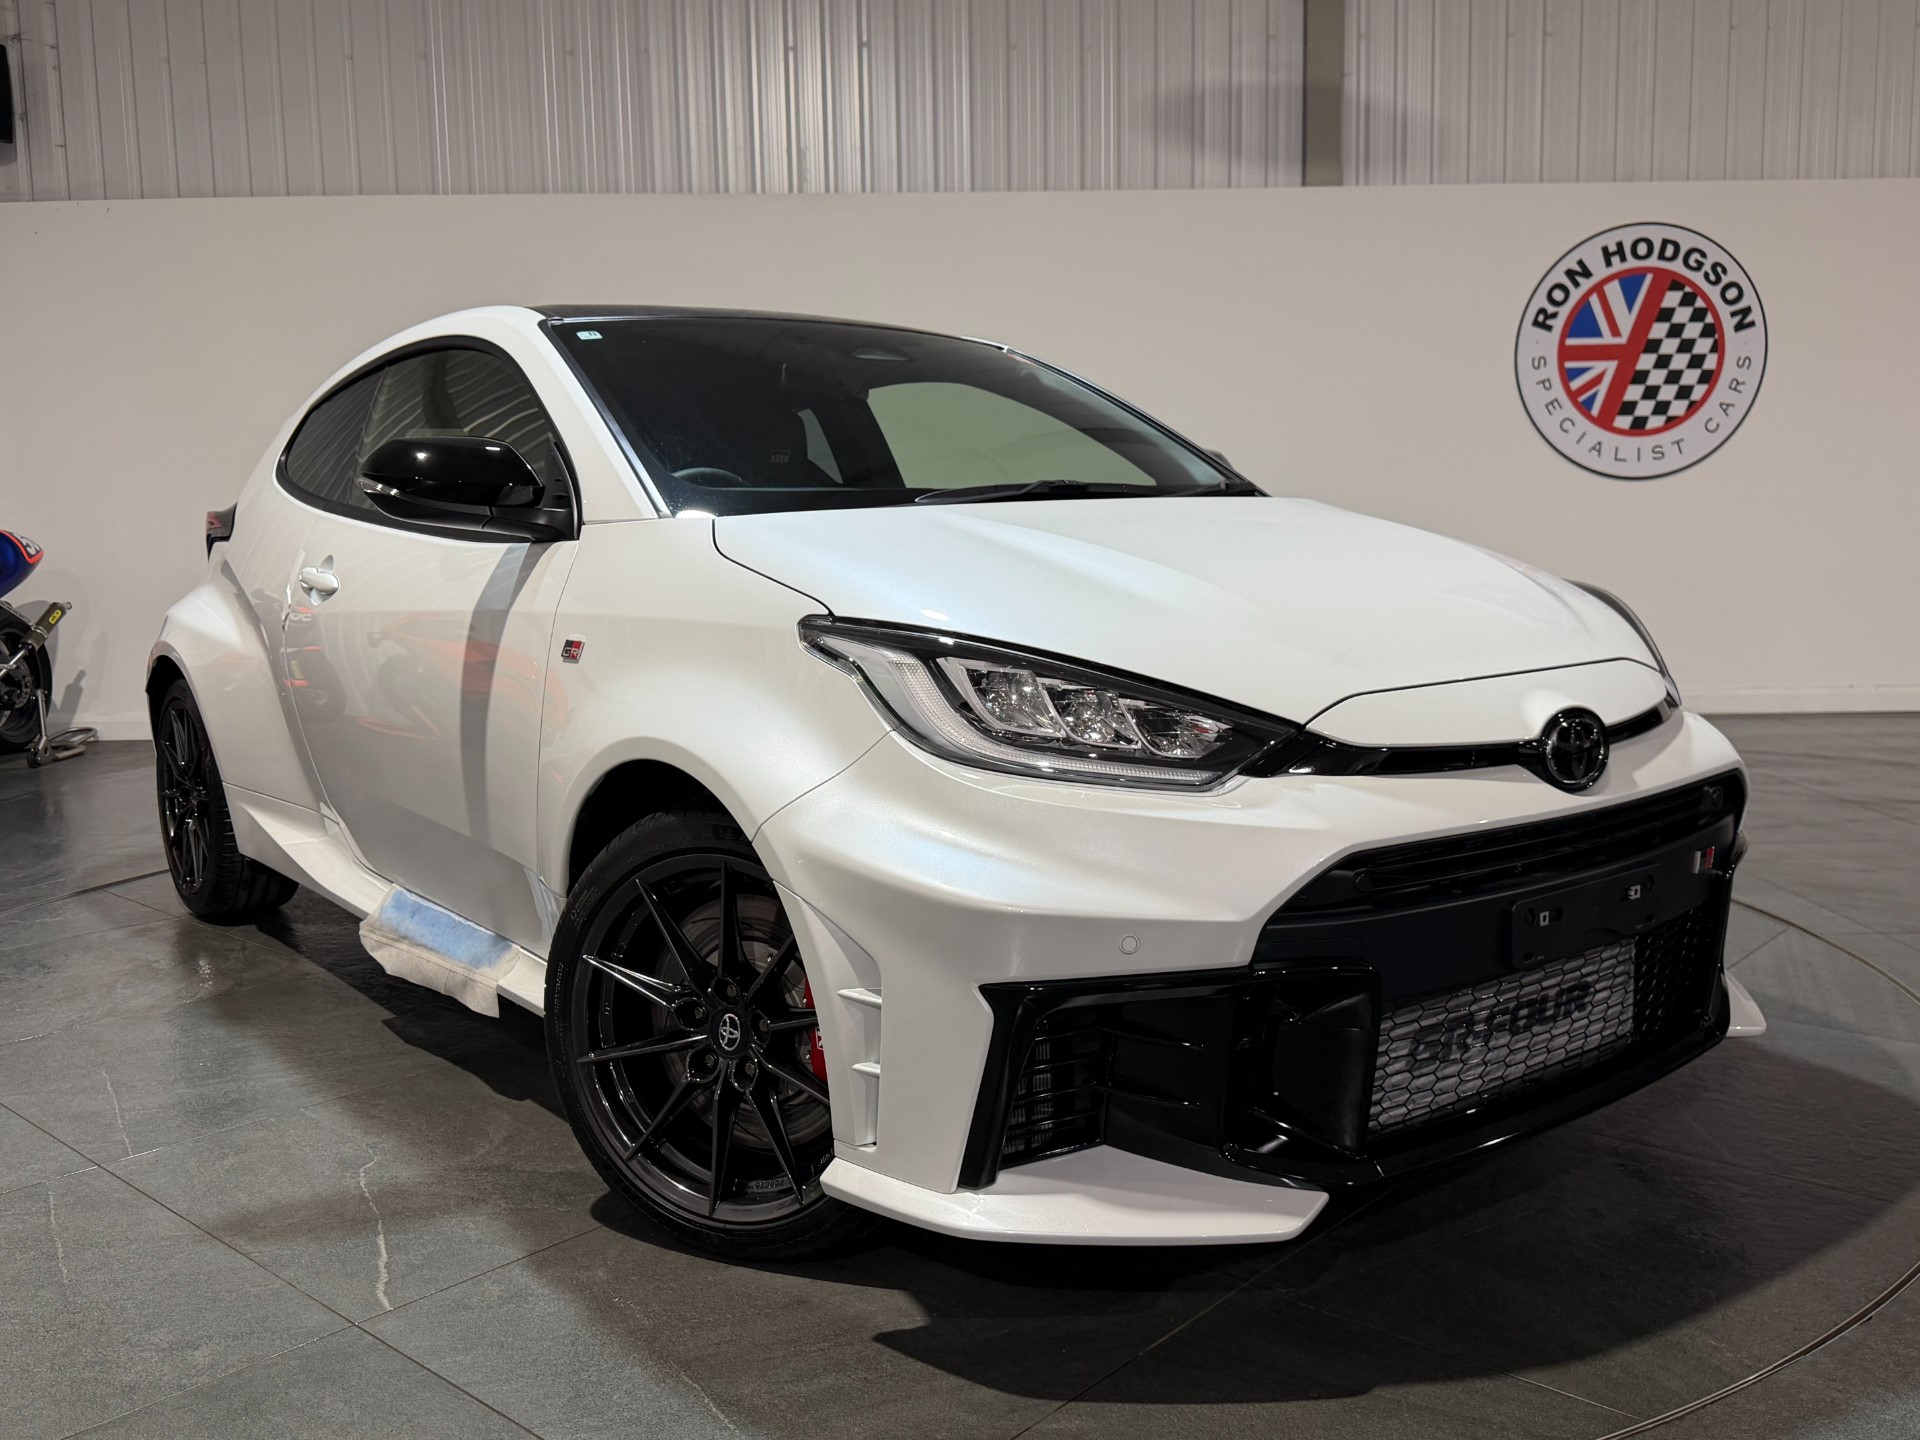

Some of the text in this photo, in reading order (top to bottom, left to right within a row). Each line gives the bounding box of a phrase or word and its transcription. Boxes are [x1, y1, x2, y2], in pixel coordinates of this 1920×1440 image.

[1531, 237, 1756, 333] RON HODGSON
[1531, 355, 1752, 462] SPECIALIST CARS
[562, 646, 579, 658] GR
